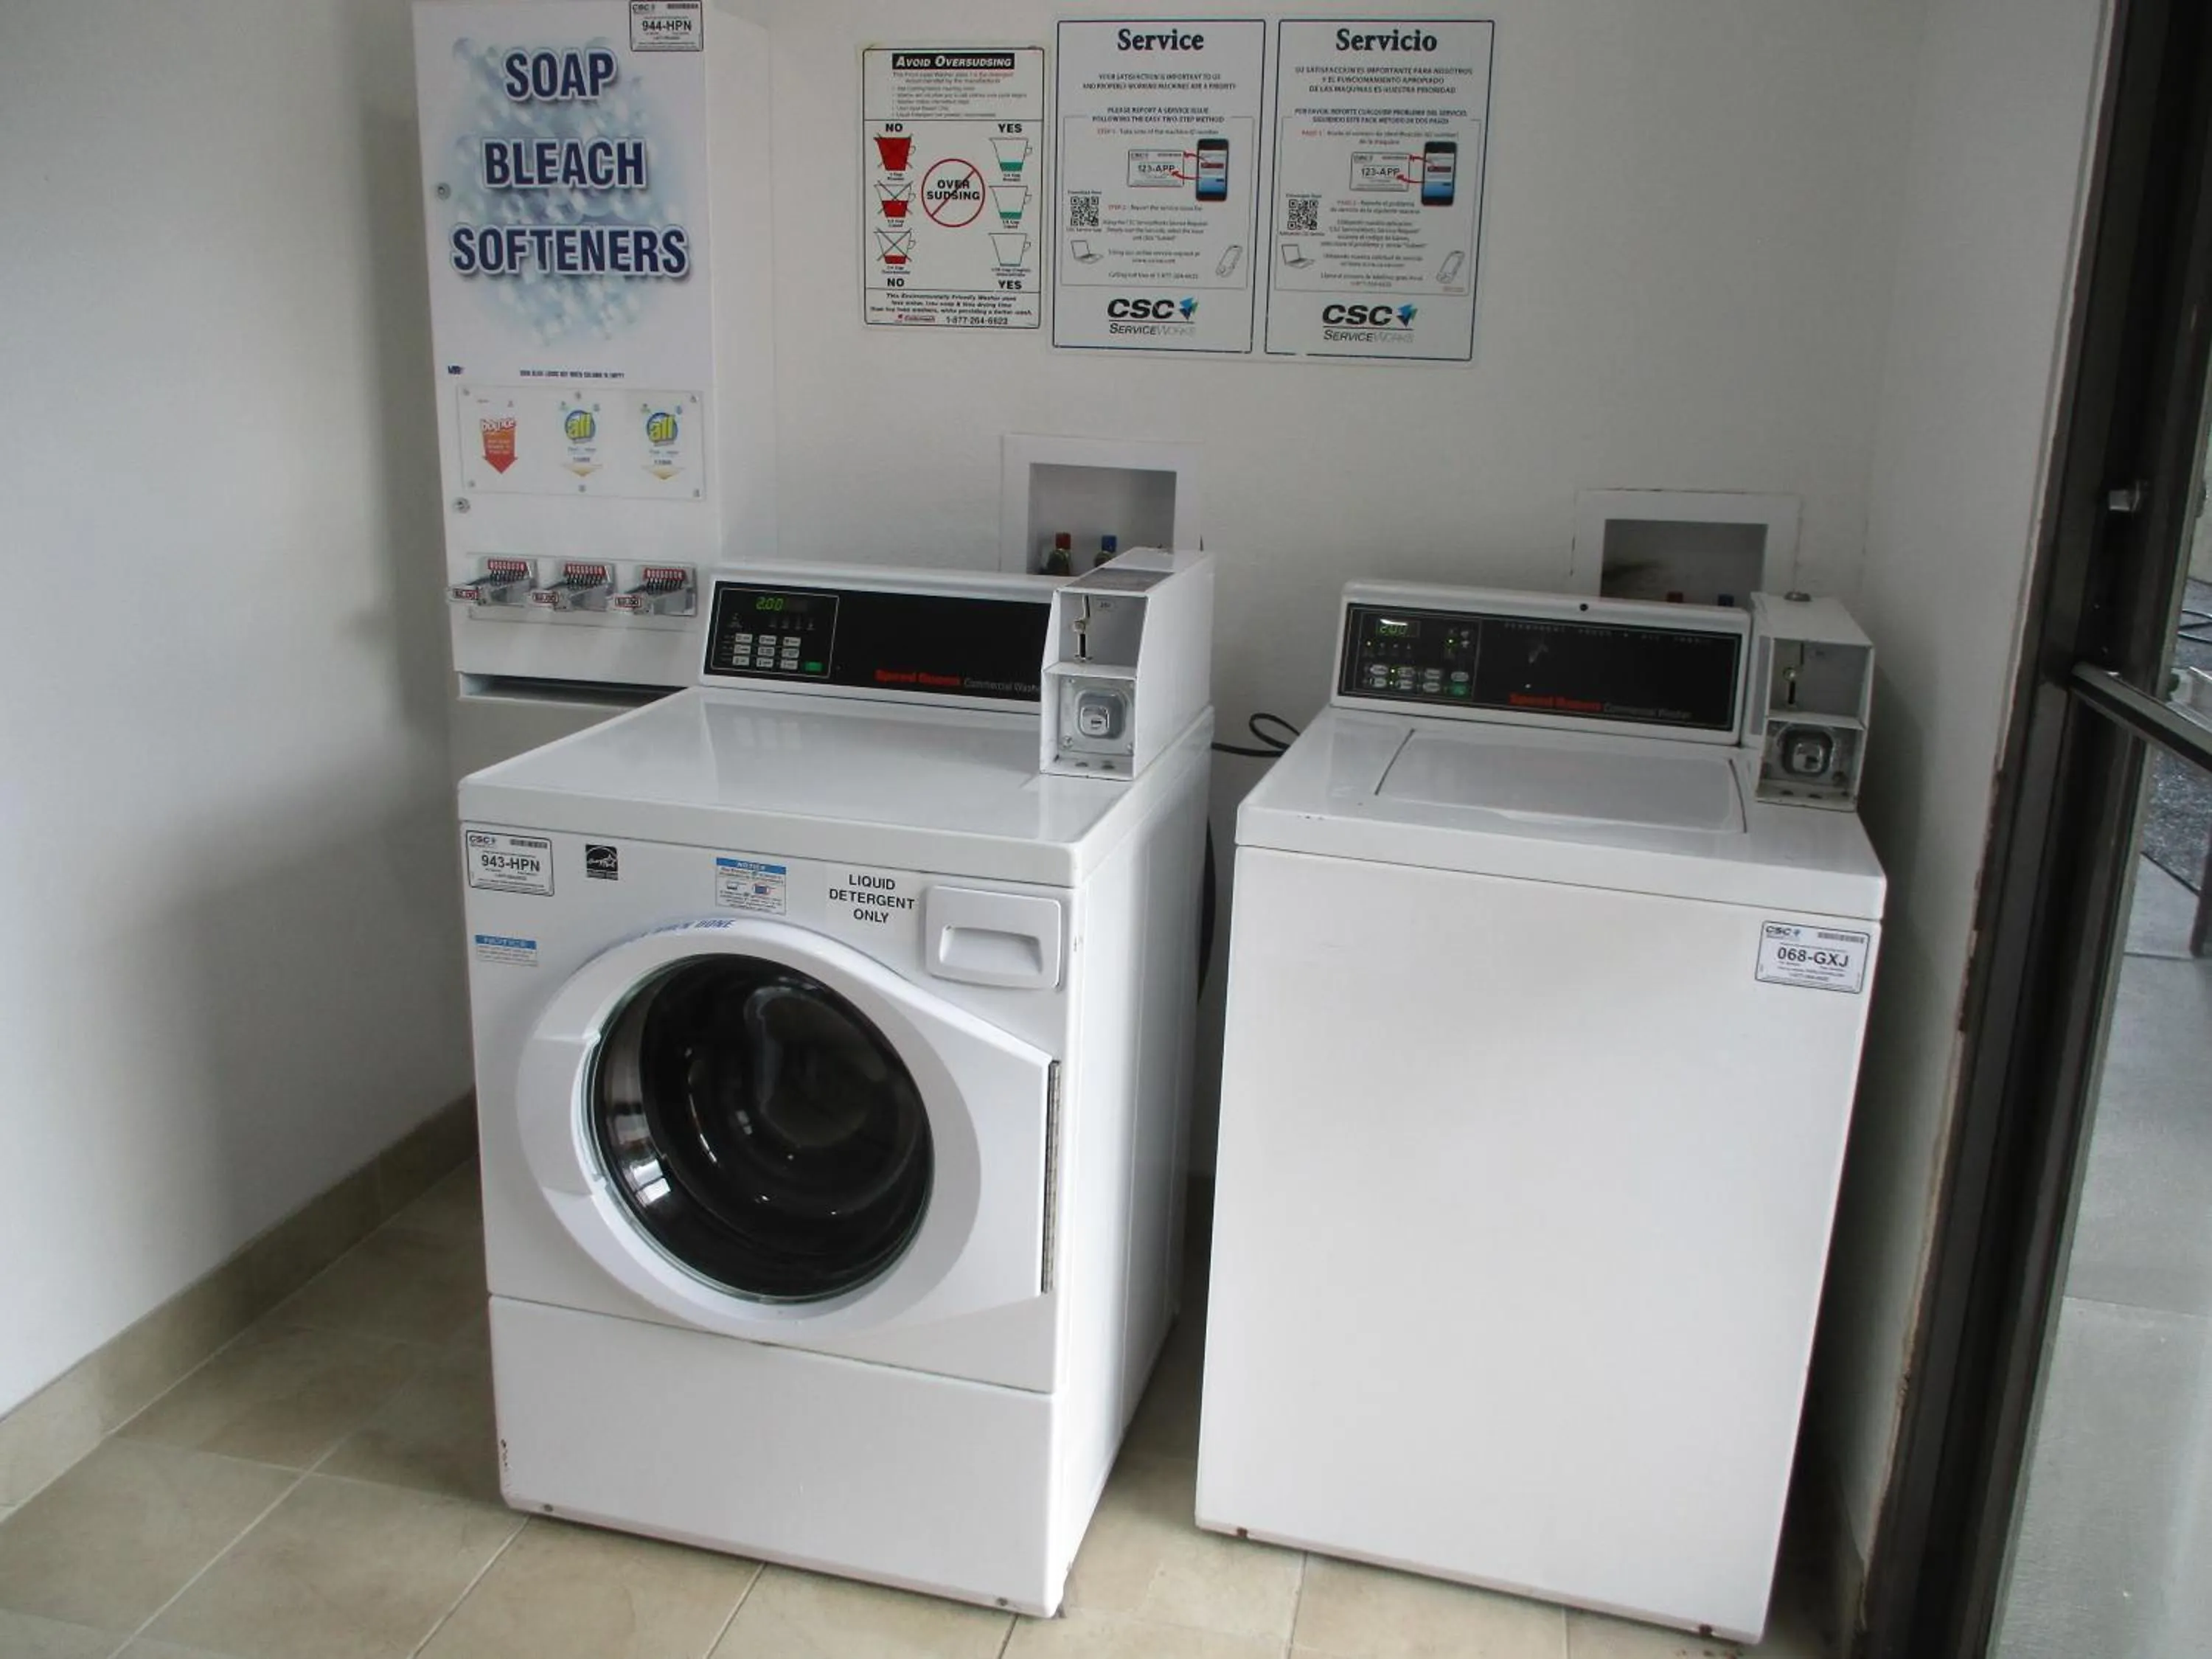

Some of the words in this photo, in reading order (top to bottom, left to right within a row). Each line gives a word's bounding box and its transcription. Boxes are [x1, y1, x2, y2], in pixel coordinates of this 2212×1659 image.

[642, 20, 692, 31] 944-HPN
[1117, 28, 1204, 51] Service
[1335, 28, 1438, 52] Servicio
[504, 52, 616, 99] SOAP
[885, 123, 903, 132] NO
[998, 124, 1023, 133] YES
[484, 141, 645, 186] BLEACH
[937, 180, 970, 189] OVER
[927, 191, 981, 200] SUDSING
[452, 227, 686, 274] SOFTENERS
[887, 278, 904, 288] NO
[998, 280, 1022, 290] YES
[1107, 299, 1175, 319] CSC
[1322, 304, 1393, 325] CSC
[567, 412, 594, 441] all
[650, 414, 675, 442] all
[481, 855, 540, 872] 943-HPN
[849, 874, 896, 891] LIQUID
[829, 889, 915, 910] DETERGENT
[853, 909, 889, 925] ONLY
[1765, 925, 1792, 936] CSC
[1777, 946, 1849, 968] 068-GXJ
